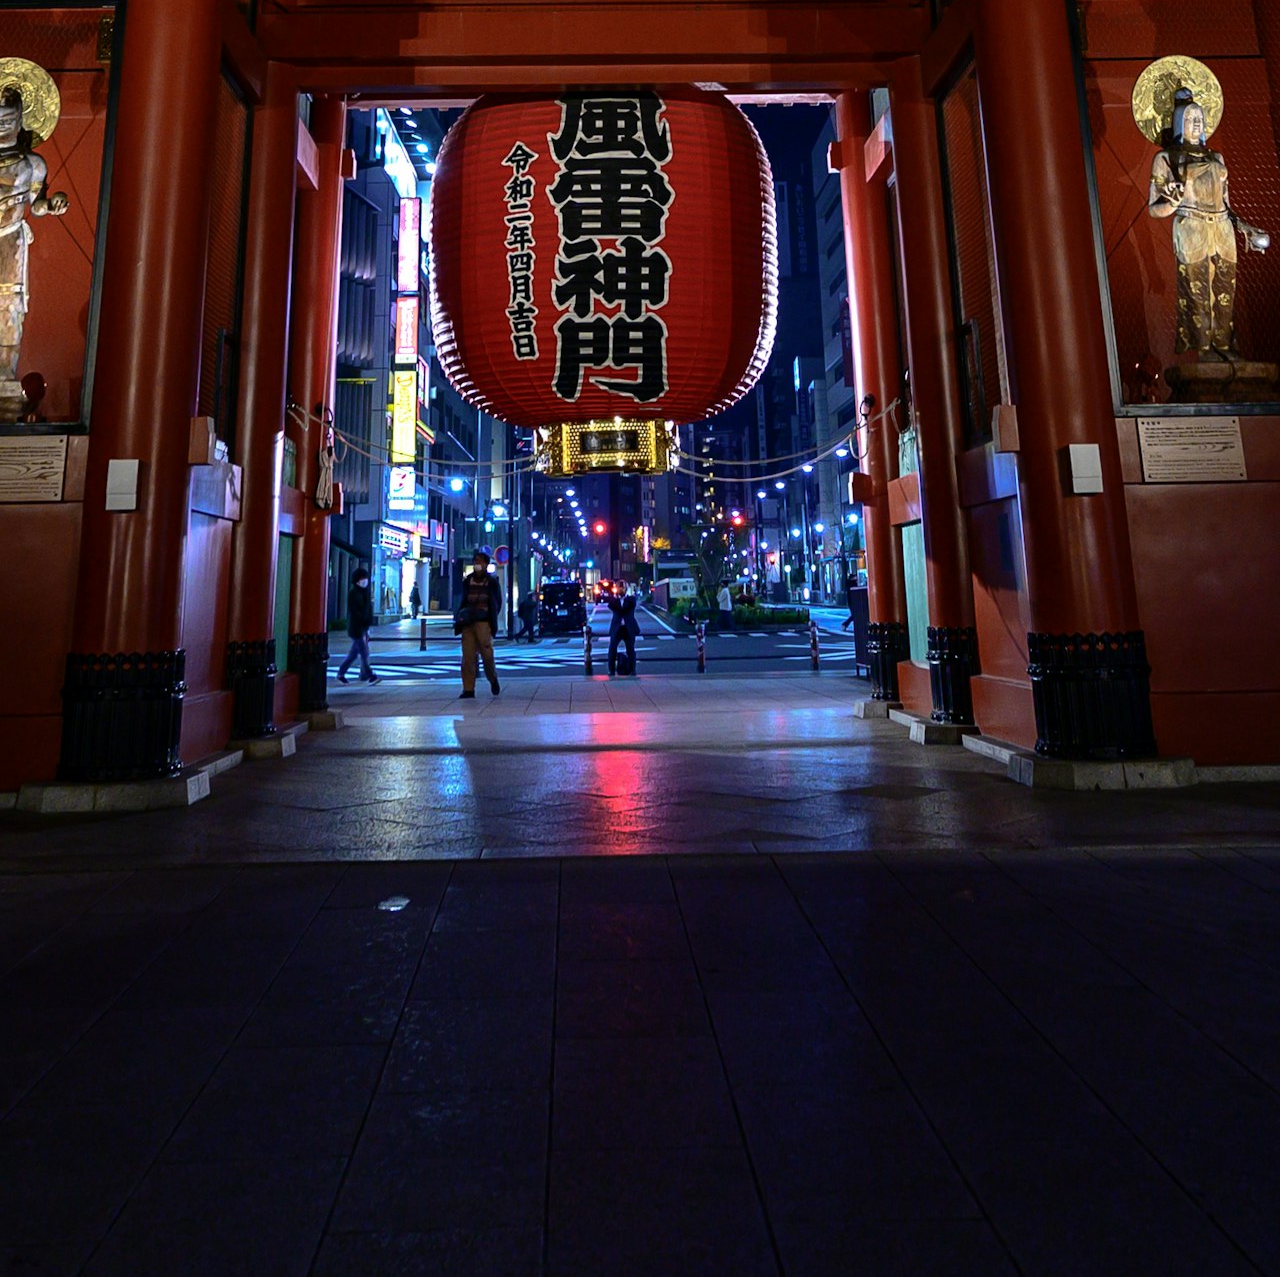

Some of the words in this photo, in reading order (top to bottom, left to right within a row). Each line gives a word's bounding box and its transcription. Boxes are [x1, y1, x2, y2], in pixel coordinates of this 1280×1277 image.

[502, 142, 539, 361] 令和二年四月吉日
[547, 94, 672, 403] 風雷神門
